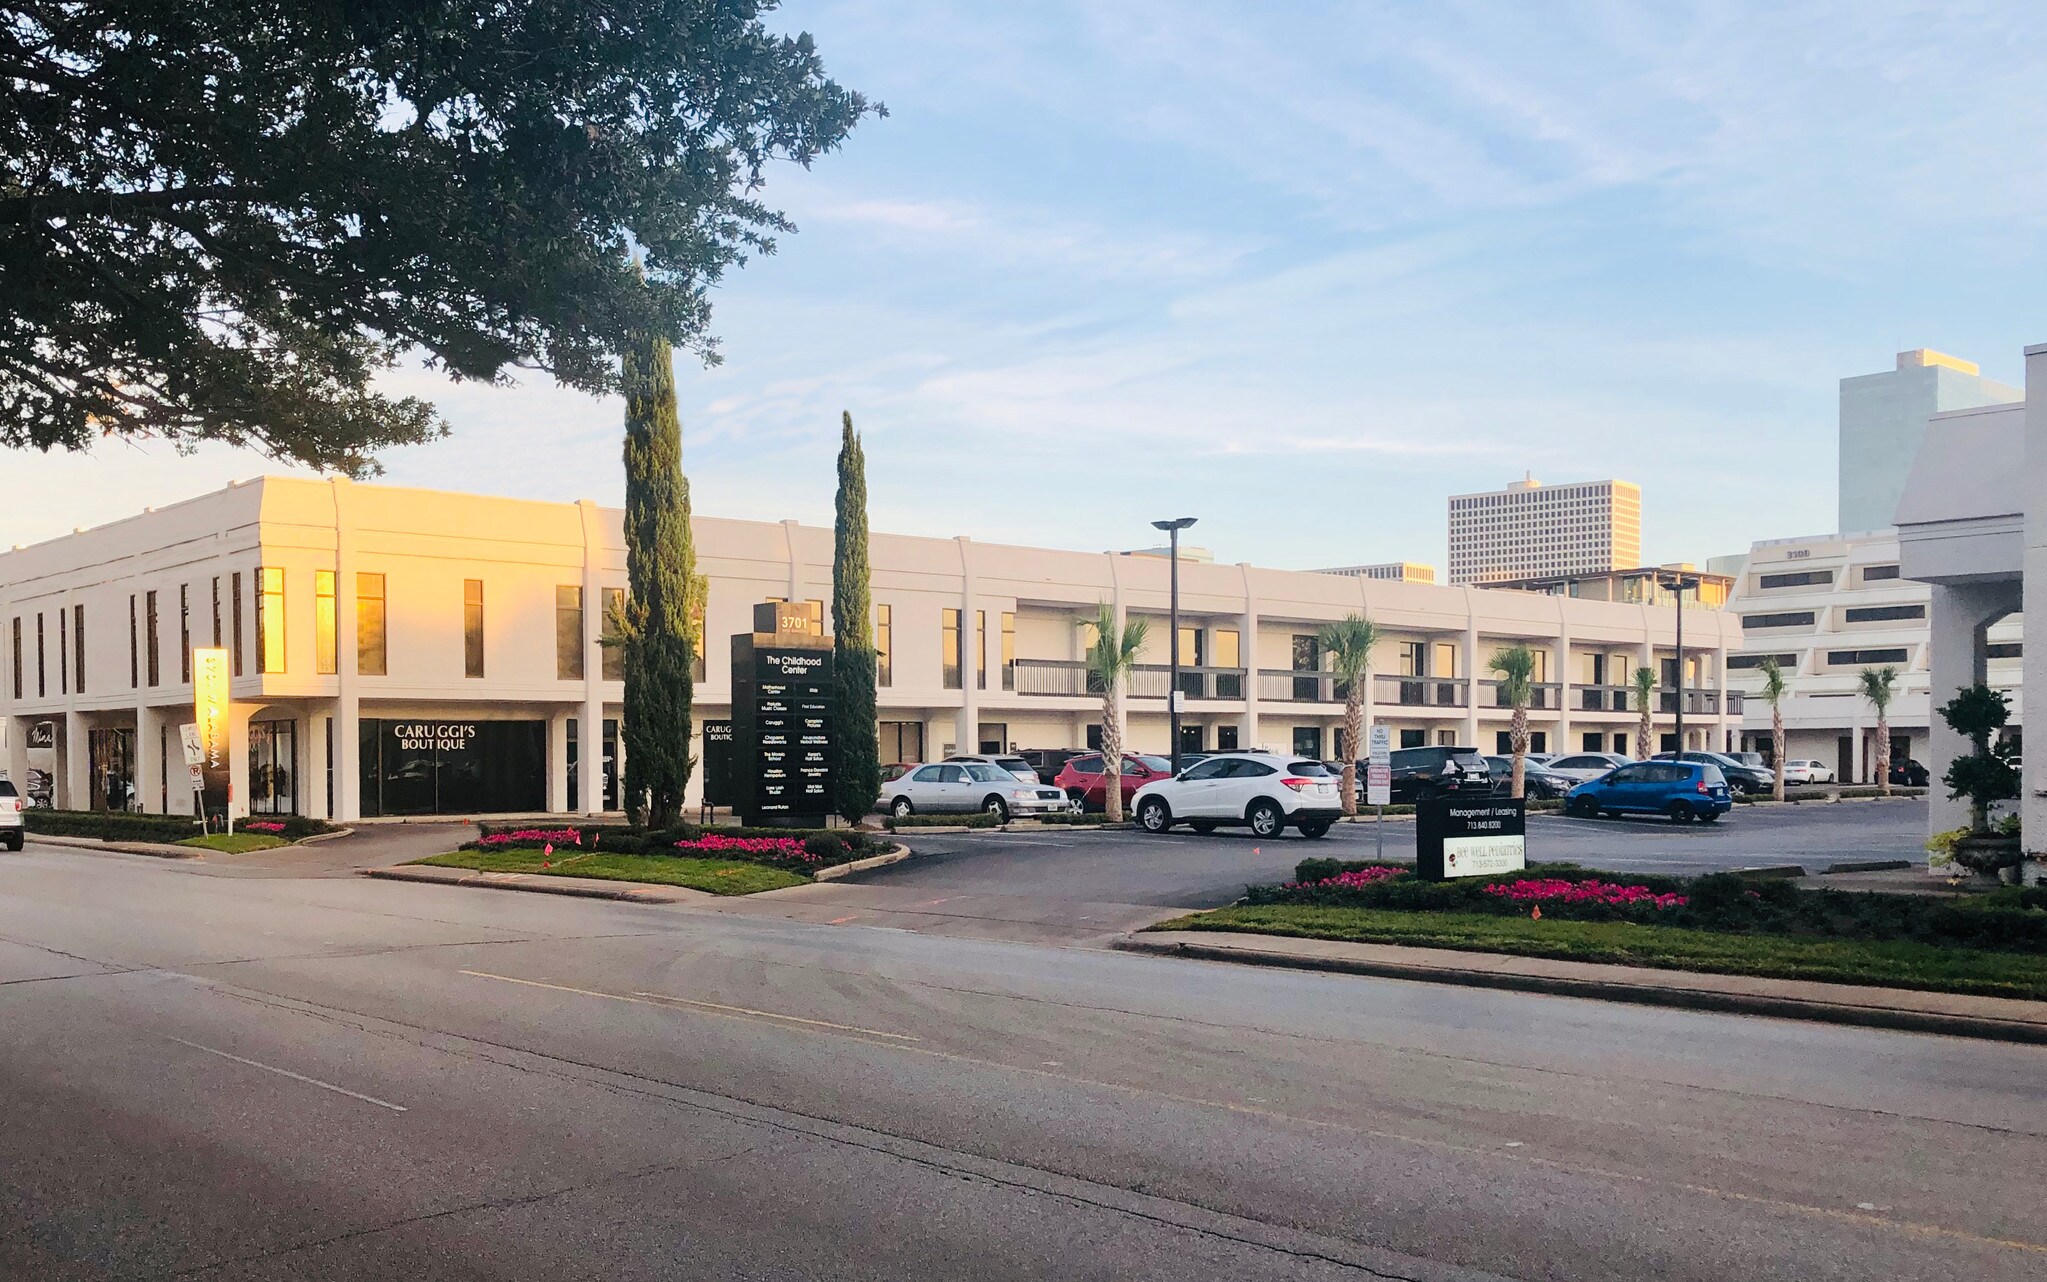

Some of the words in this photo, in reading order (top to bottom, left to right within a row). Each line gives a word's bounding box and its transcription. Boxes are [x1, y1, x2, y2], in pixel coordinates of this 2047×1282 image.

[781, 616, 807, 629] 3701
[766, 656, 780, 665] The
[781, 656, 822, 667] Childhood
[781, 665, 808, 674] Center
[394, 724, 476, 738] CARUGGI'S
[207, 707, 220, 769] ALABAMA
[401, 738, 466, 751] BOUTIQUE
[1449, 808, 1490, 818] Management
[1495, 806, 1517, 817] Leasing
